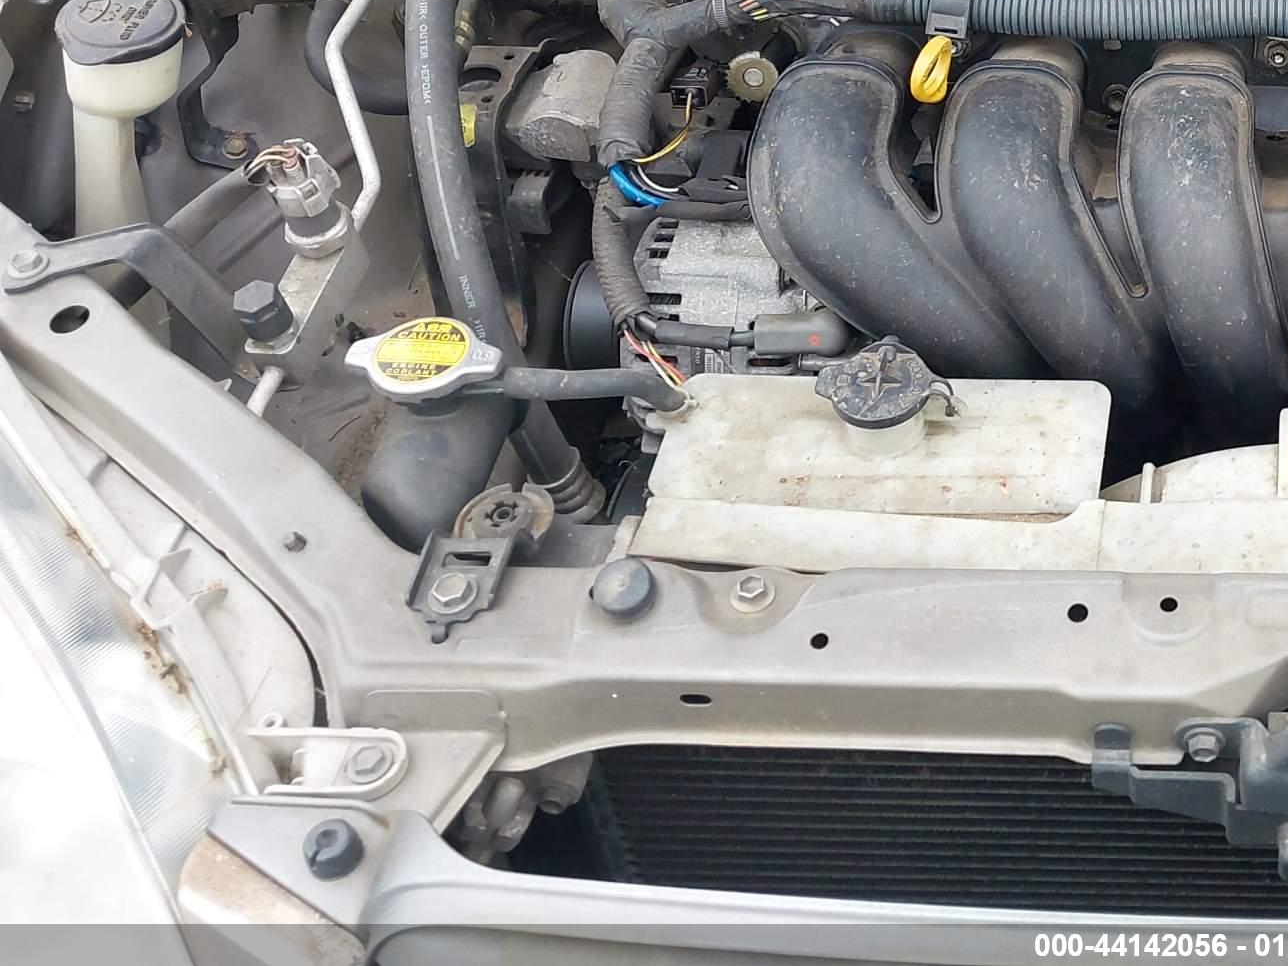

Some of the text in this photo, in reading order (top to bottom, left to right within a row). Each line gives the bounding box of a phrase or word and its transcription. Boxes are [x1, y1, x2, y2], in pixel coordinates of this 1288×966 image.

[418, 24, 429, 60] OUTER
[397, 331, 462, 342] CAUTION
[384, 368, 438, 376] COOLANT
